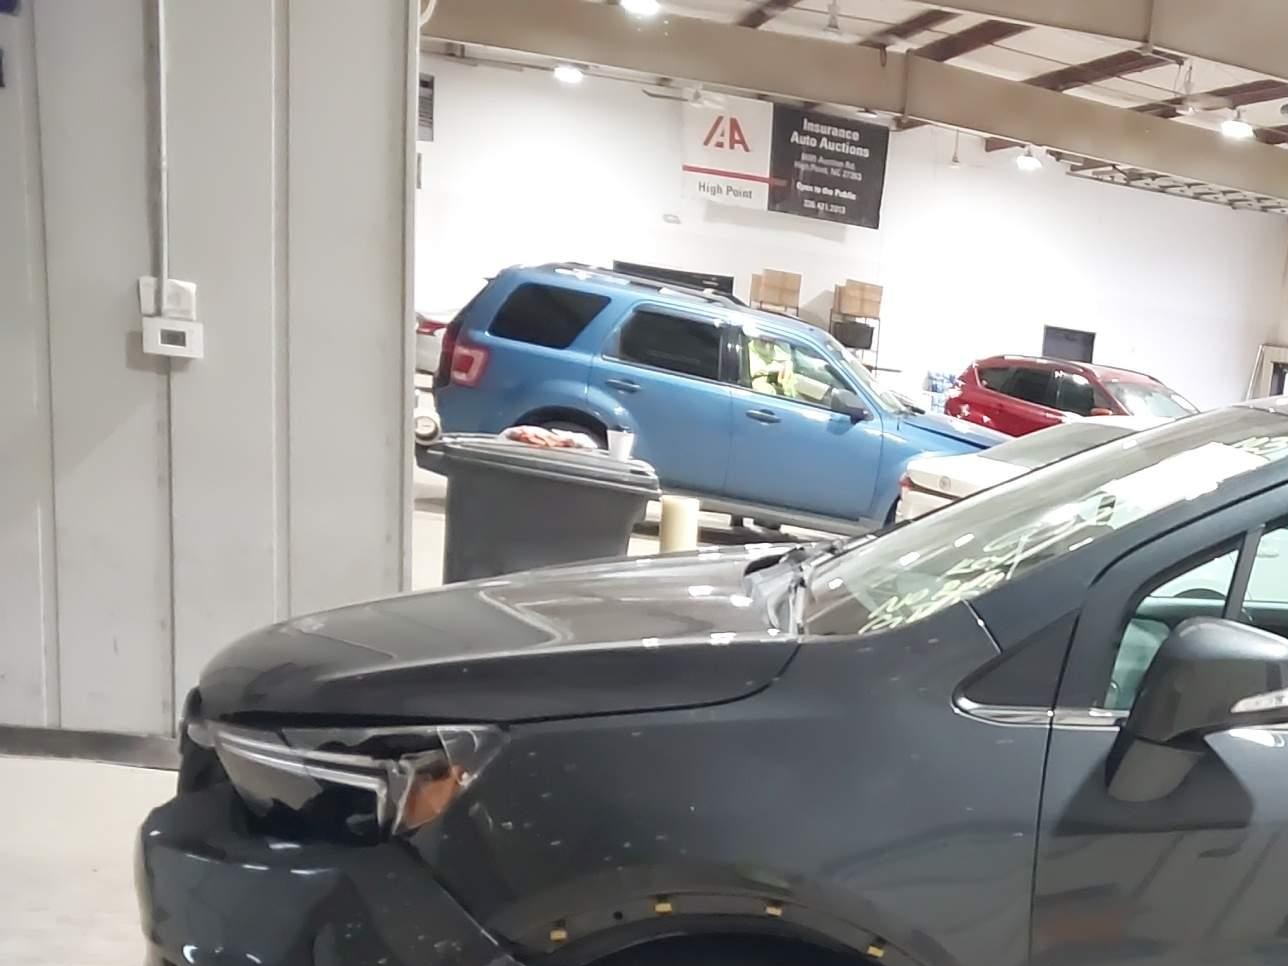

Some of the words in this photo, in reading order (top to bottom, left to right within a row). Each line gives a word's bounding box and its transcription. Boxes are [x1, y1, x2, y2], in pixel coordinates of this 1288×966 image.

[803, 118, 860, 142] Insurance
[790, 130, 818, 148] Auto
[819, 136, 870, 158] Auctions
[698, 181, 723, 196] High
[726, 185, 753, 199] Point
